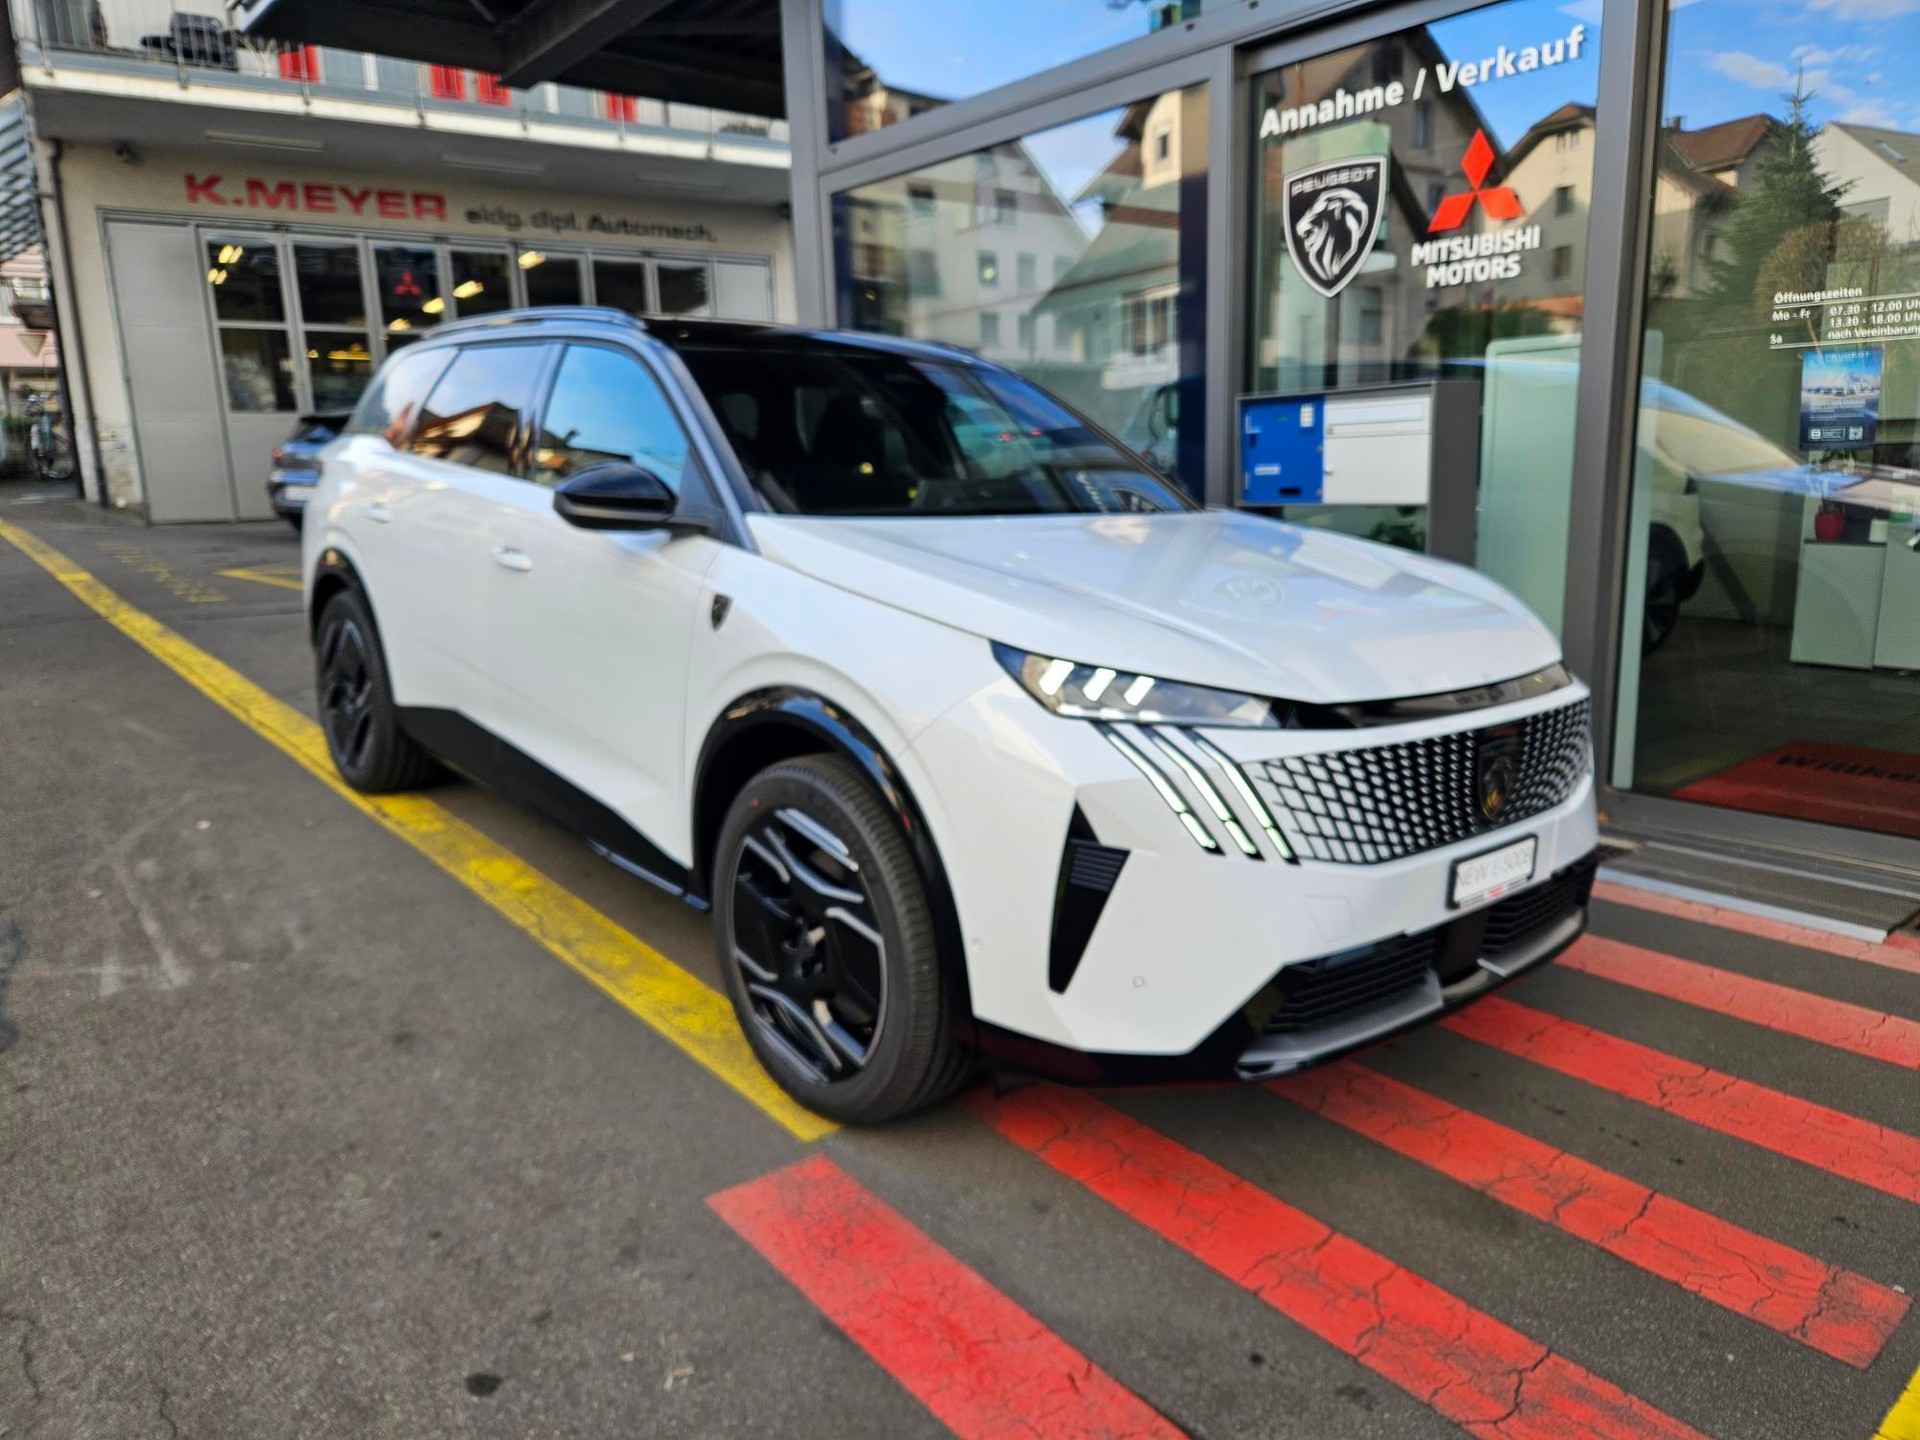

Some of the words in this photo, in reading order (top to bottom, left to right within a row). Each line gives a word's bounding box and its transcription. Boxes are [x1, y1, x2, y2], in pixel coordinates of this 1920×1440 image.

[1260, 80, 1404, 139] Annahme
[1412, 67, 1428, 101] /
[1435, 24, 1586, 93] Verkauf
[184, 172, 447, 221] K.MEYER
[1291, 165, 1378, 197] PEUGEOT
[1411, 224, 1541, 267] MITSUBISHI
[1426, 253, 1521, 289] MOTORS
[1772, 310, 1791, 322] Mo
[1799, 308, 1812, 320] Fr
[1829, 304, 1860, 316] 07.30
[1871, 300, 1902, 313] 12.00
[1774, 287, 1863, 303] Öffnungszeiten
[1770, 332, 1783, 345] Sa
[1827, 327, 1852, 341] nach
[1854, 324, 1920, 338] Vereinbarun
[1829, 316, 1860, 328] 13.30
[1870, 312, 1901, 325] 18.00
